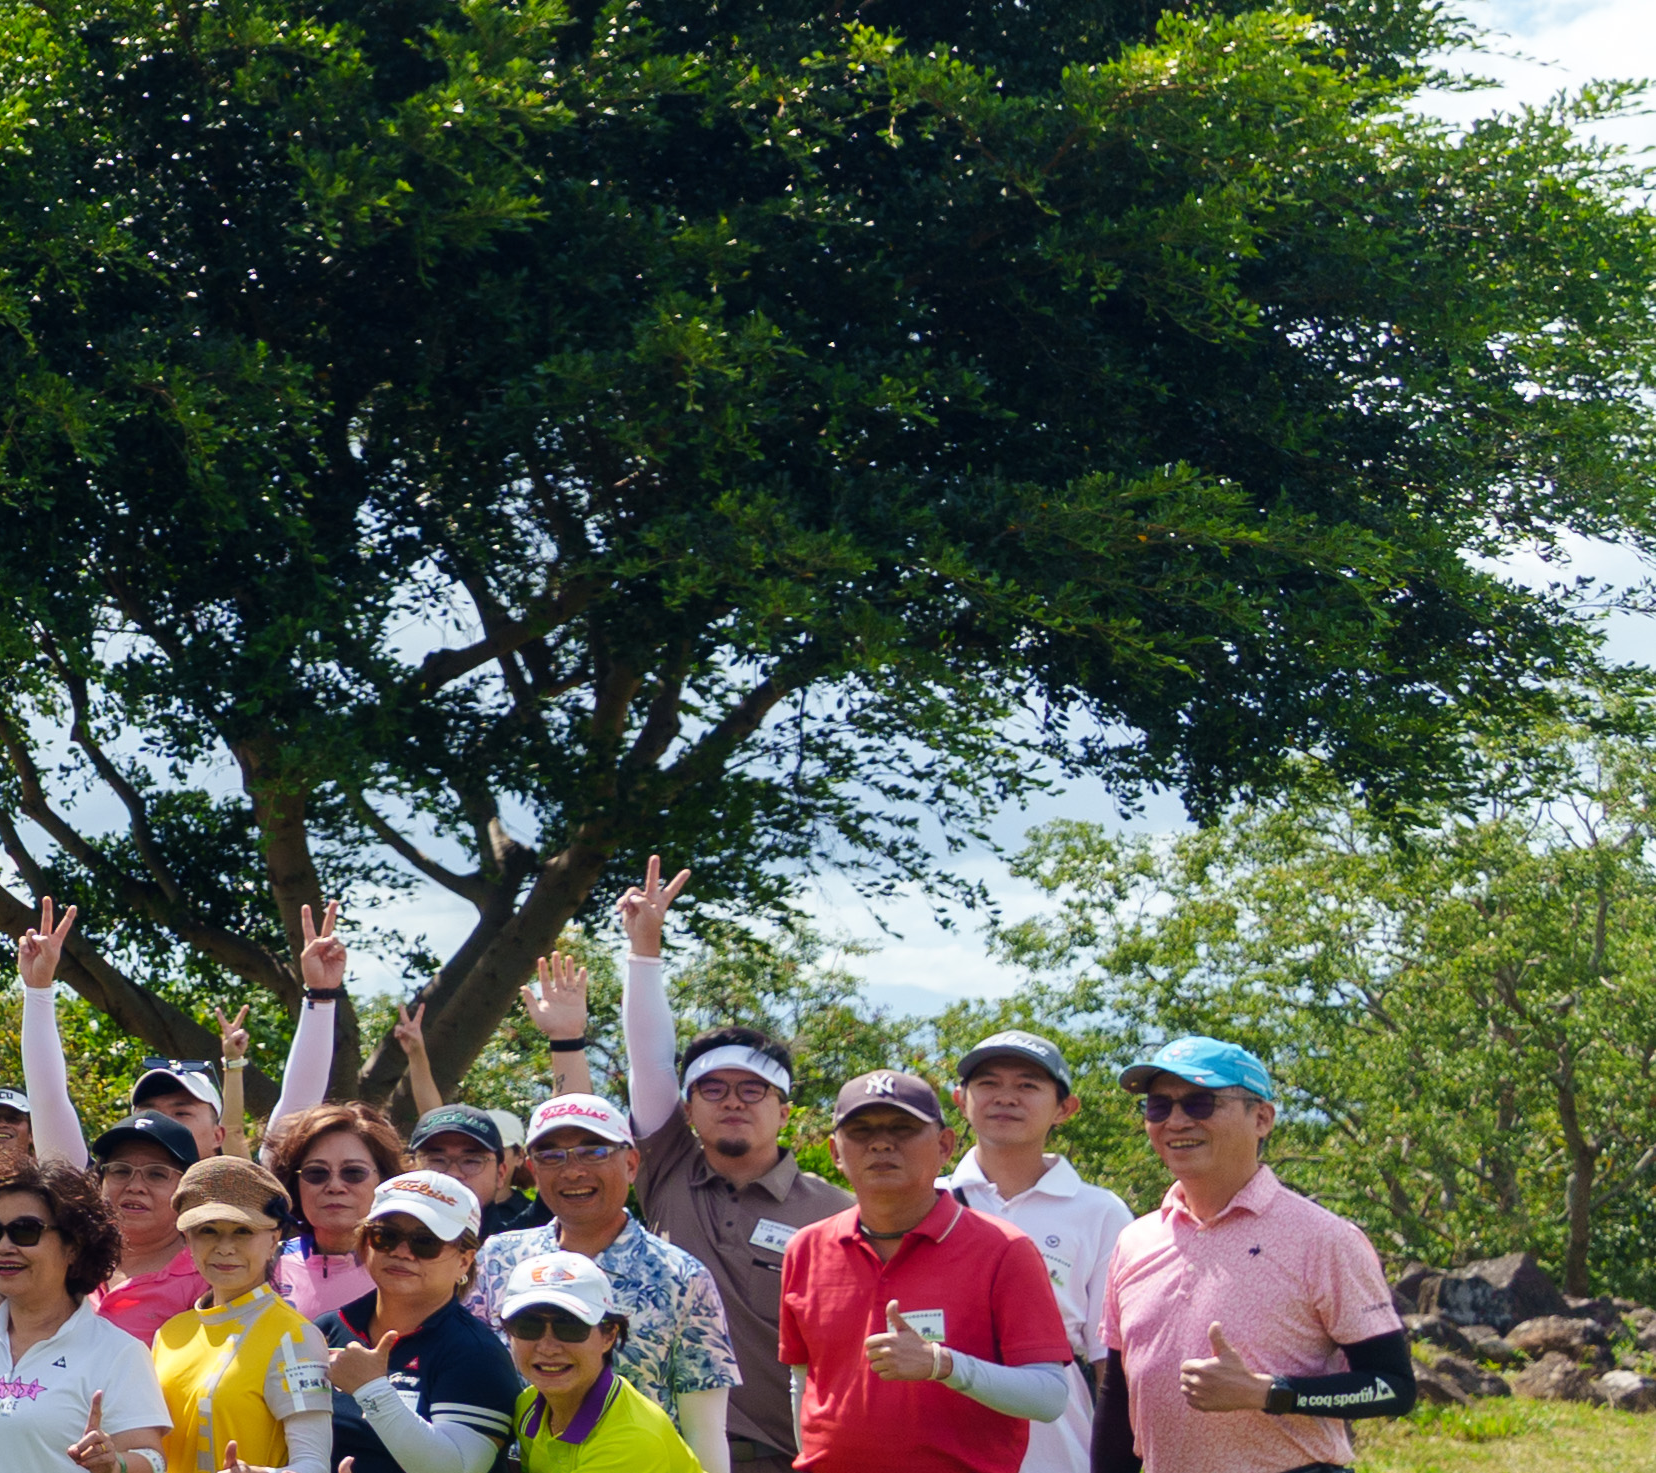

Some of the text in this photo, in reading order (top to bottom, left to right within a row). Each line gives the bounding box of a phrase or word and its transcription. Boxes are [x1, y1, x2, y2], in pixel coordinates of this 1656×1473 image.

[538, 1102, 611, 1127] Titleist
[392, 1180, 457, 1207] Titleist
[1297, 1387, 1374, 1409] le coq sportif
